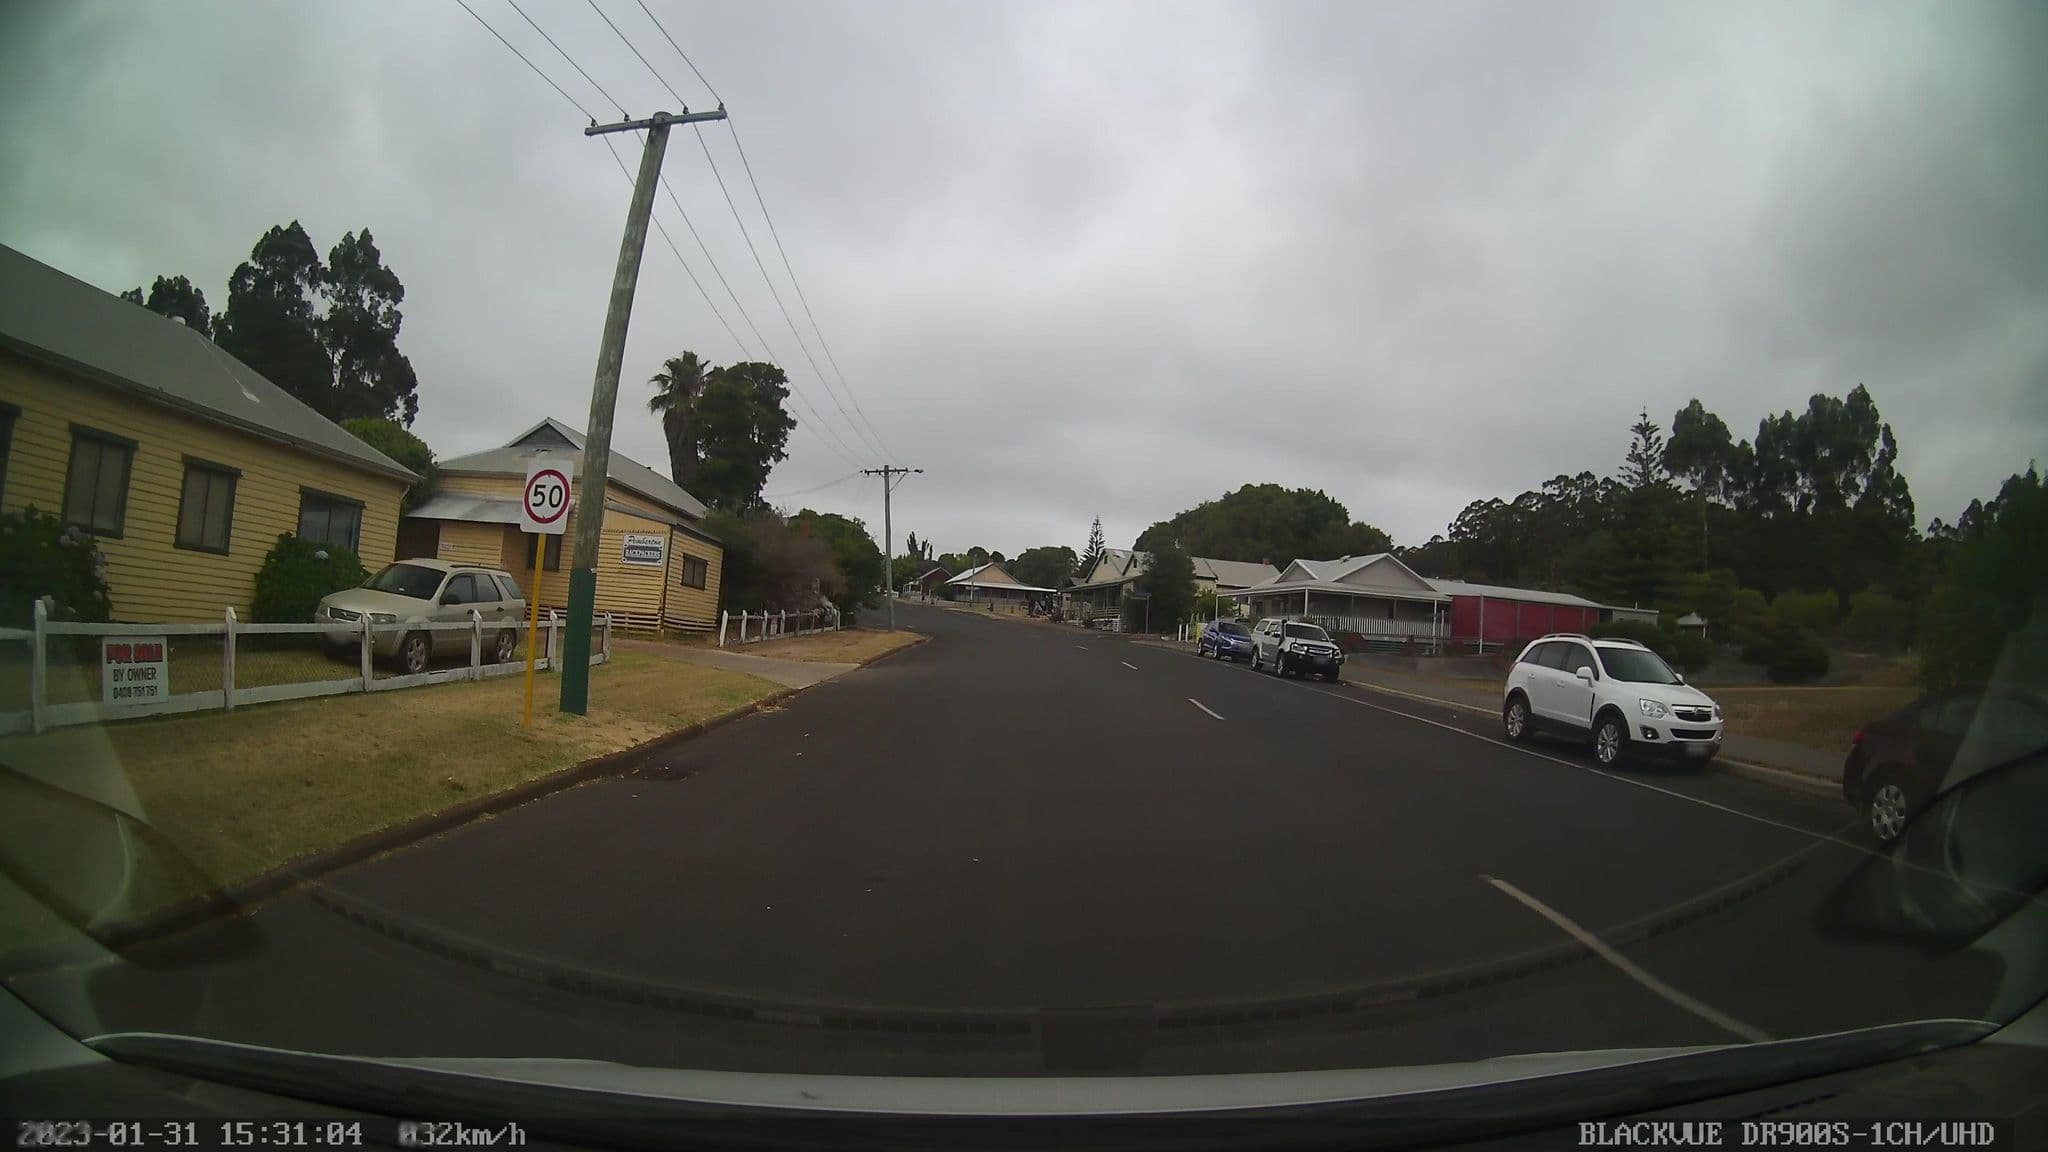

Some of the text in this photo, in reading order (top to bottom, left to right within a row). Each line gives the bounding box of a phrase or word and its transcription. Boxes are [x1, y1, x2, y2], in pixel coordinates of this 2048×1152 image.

[532, 484, 563, 508] 50
[113, 667, 157, 682] BY OWNER
